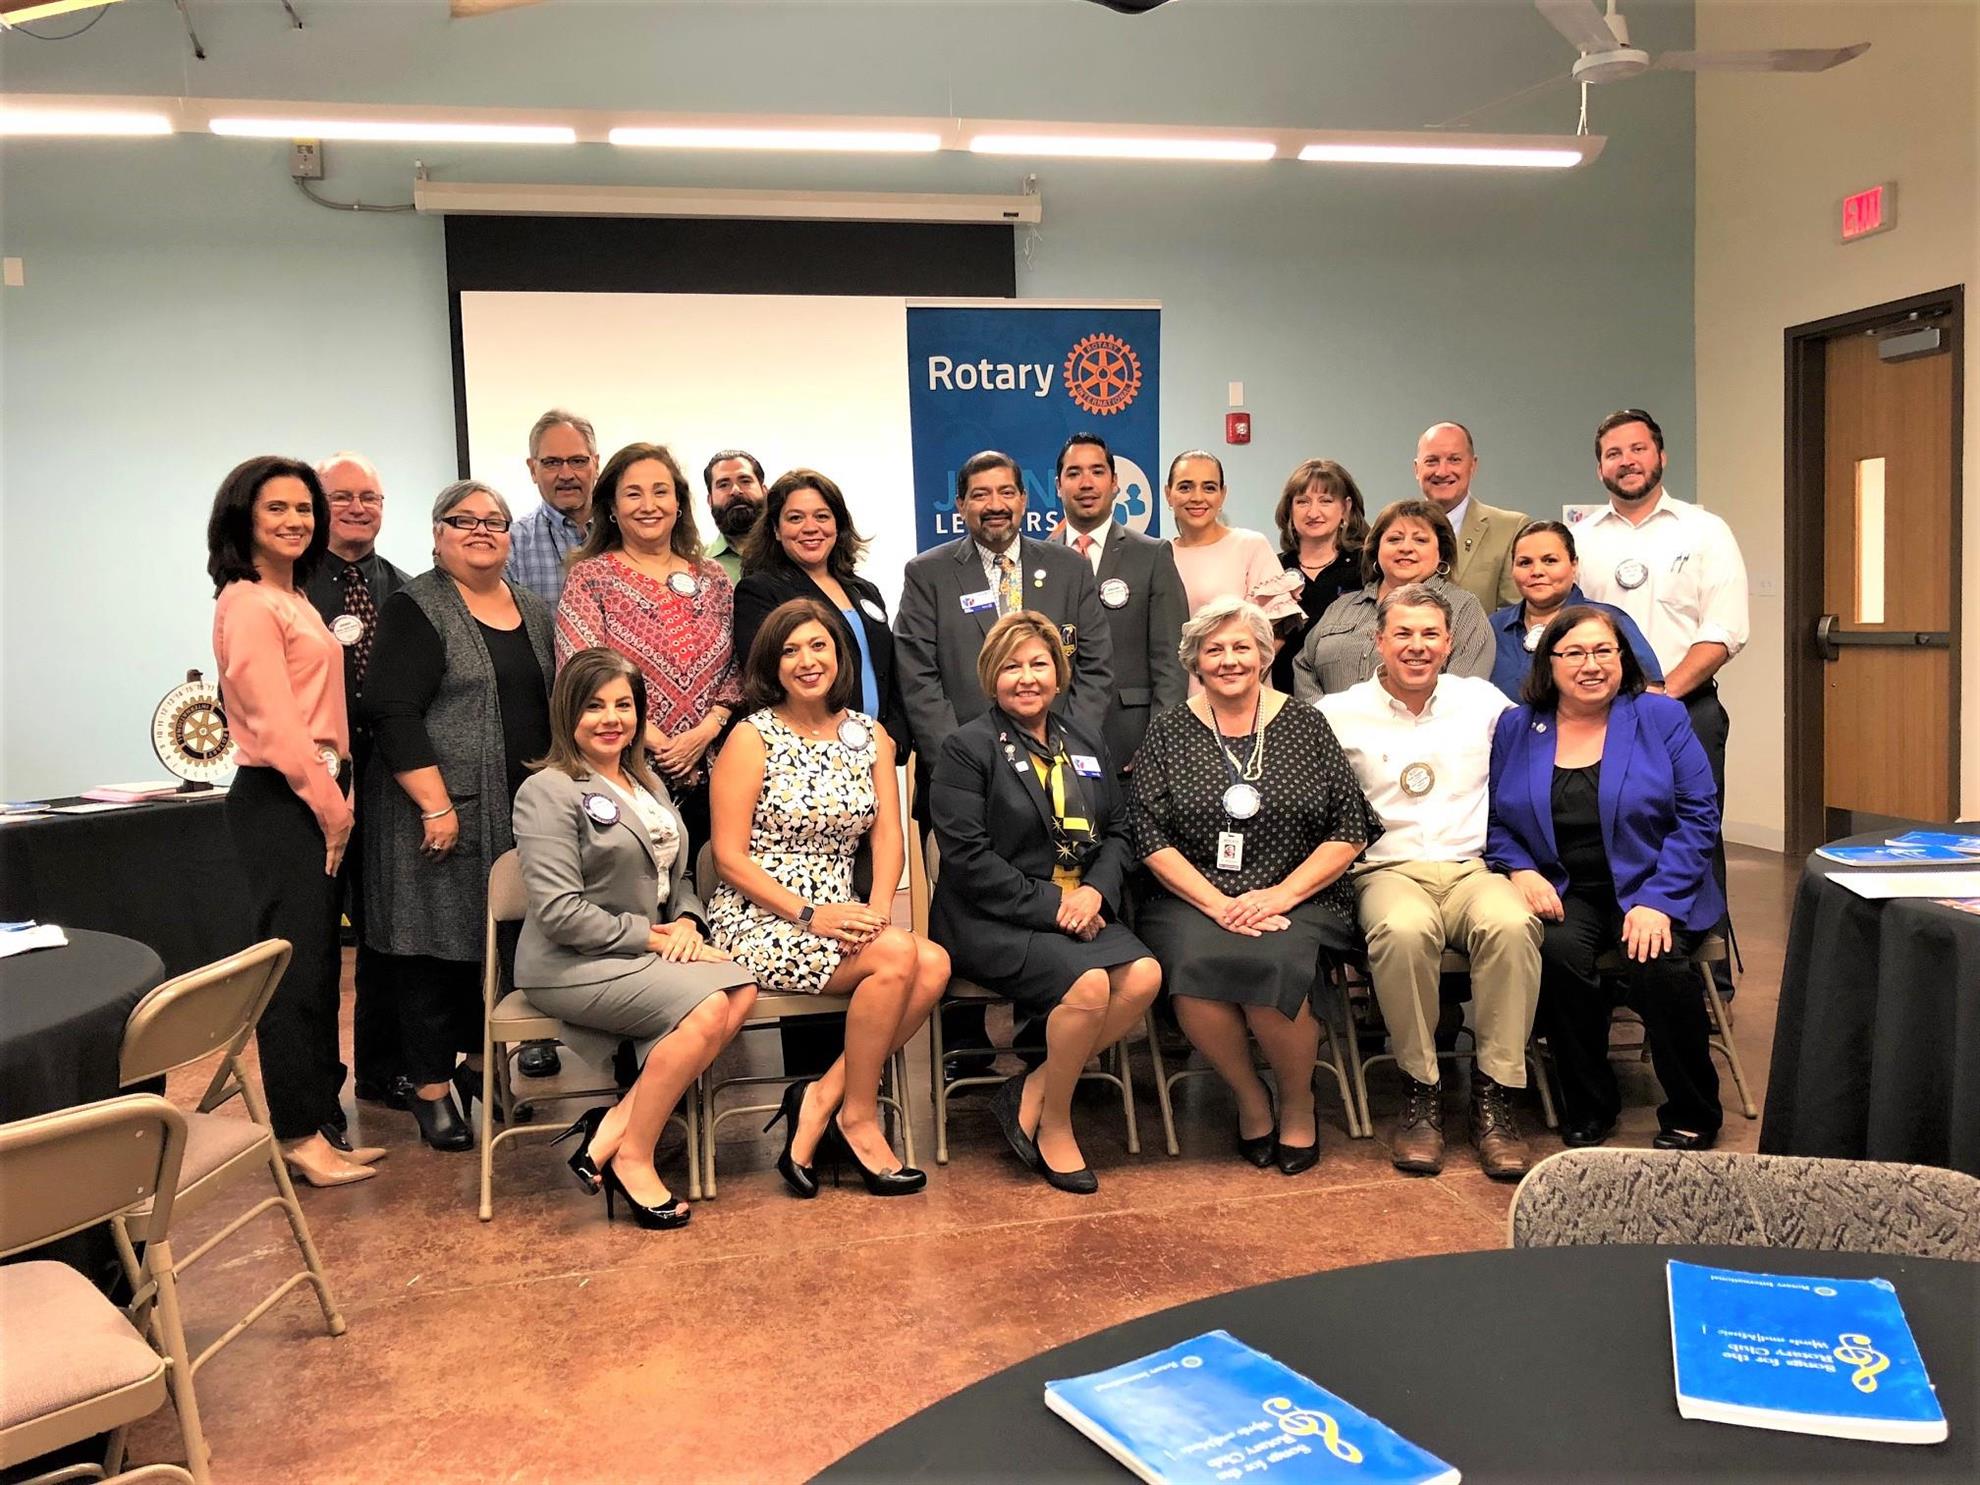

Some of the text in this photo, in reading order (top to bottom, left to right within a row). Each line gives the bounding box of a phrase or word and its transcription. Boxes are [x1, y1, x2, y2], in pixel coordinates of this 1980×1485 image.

[1086, 341, 1119, 352] ROTARY
[928, 355, 1054, 397] Rotary
[1076, 384, 1132, 407] INTERNATIONAL
[933, 469, 1057, 511] JN
[936, 511, 1059, 534] LERS
[1721, 1351, 1836, 1373] Songs for the
[1727, 1343, 1834, 1364] Rotary Club
